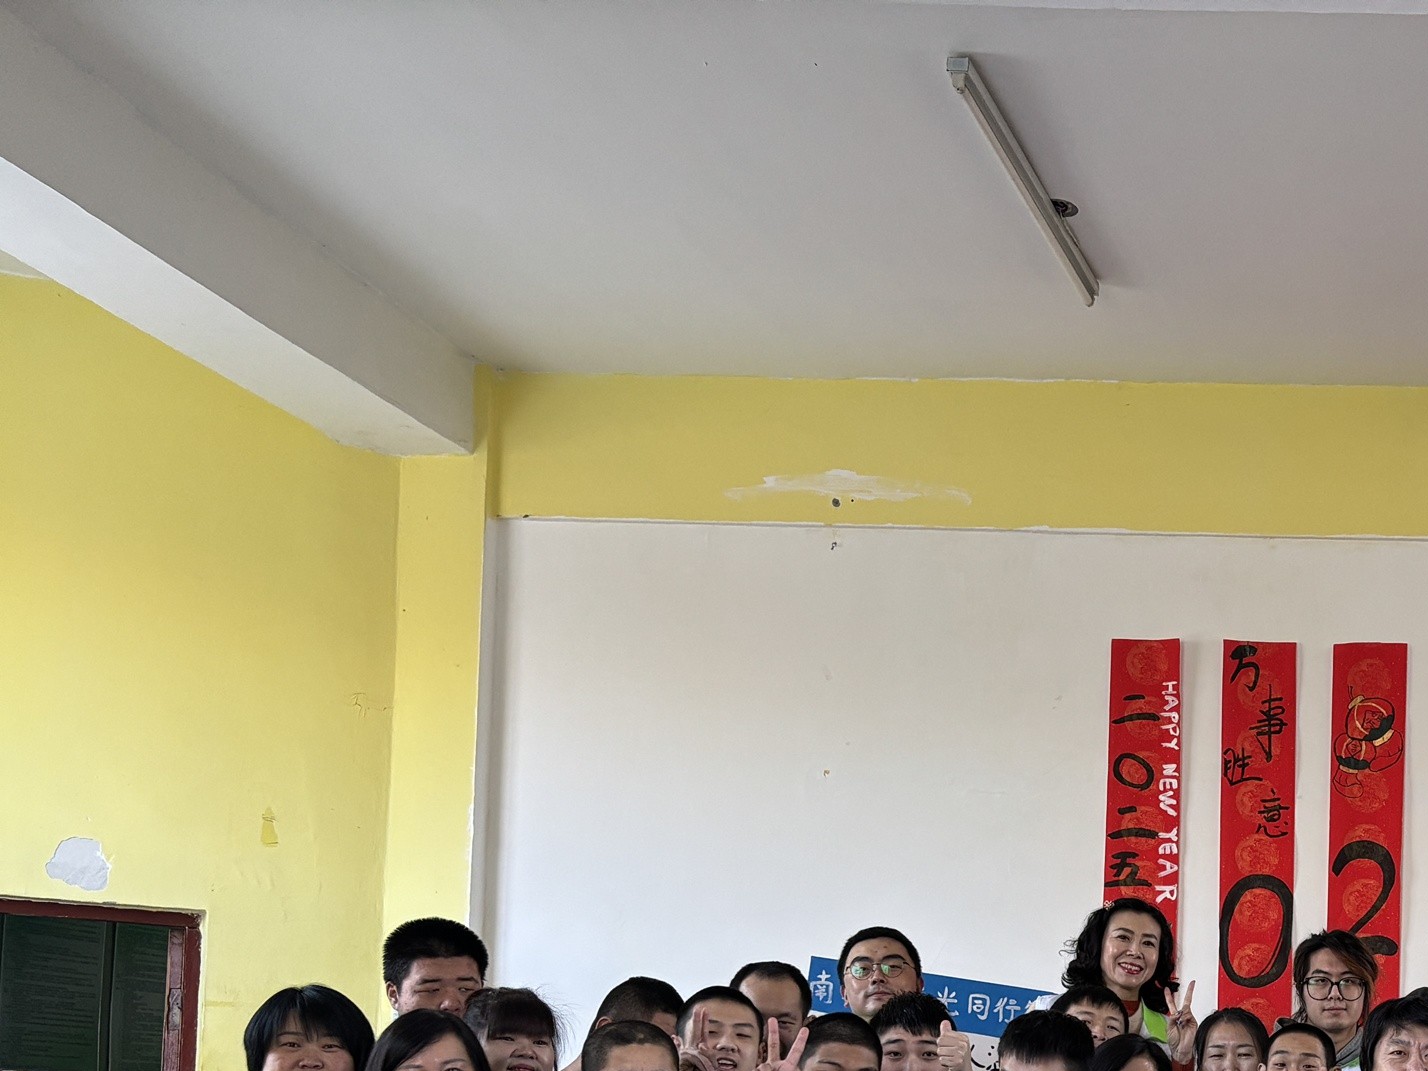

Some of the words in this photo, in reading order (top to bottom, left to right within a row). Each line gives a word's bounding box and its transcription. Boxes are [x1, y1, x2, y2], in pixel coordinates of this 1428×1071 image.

[1160, 680, 1180, 750] HAPPY
[1223, 642, 1289, 838] 万事胜意
[1158, 763, 1178, 818] NEW
[1155, 827, 1179, 904] YEAR
